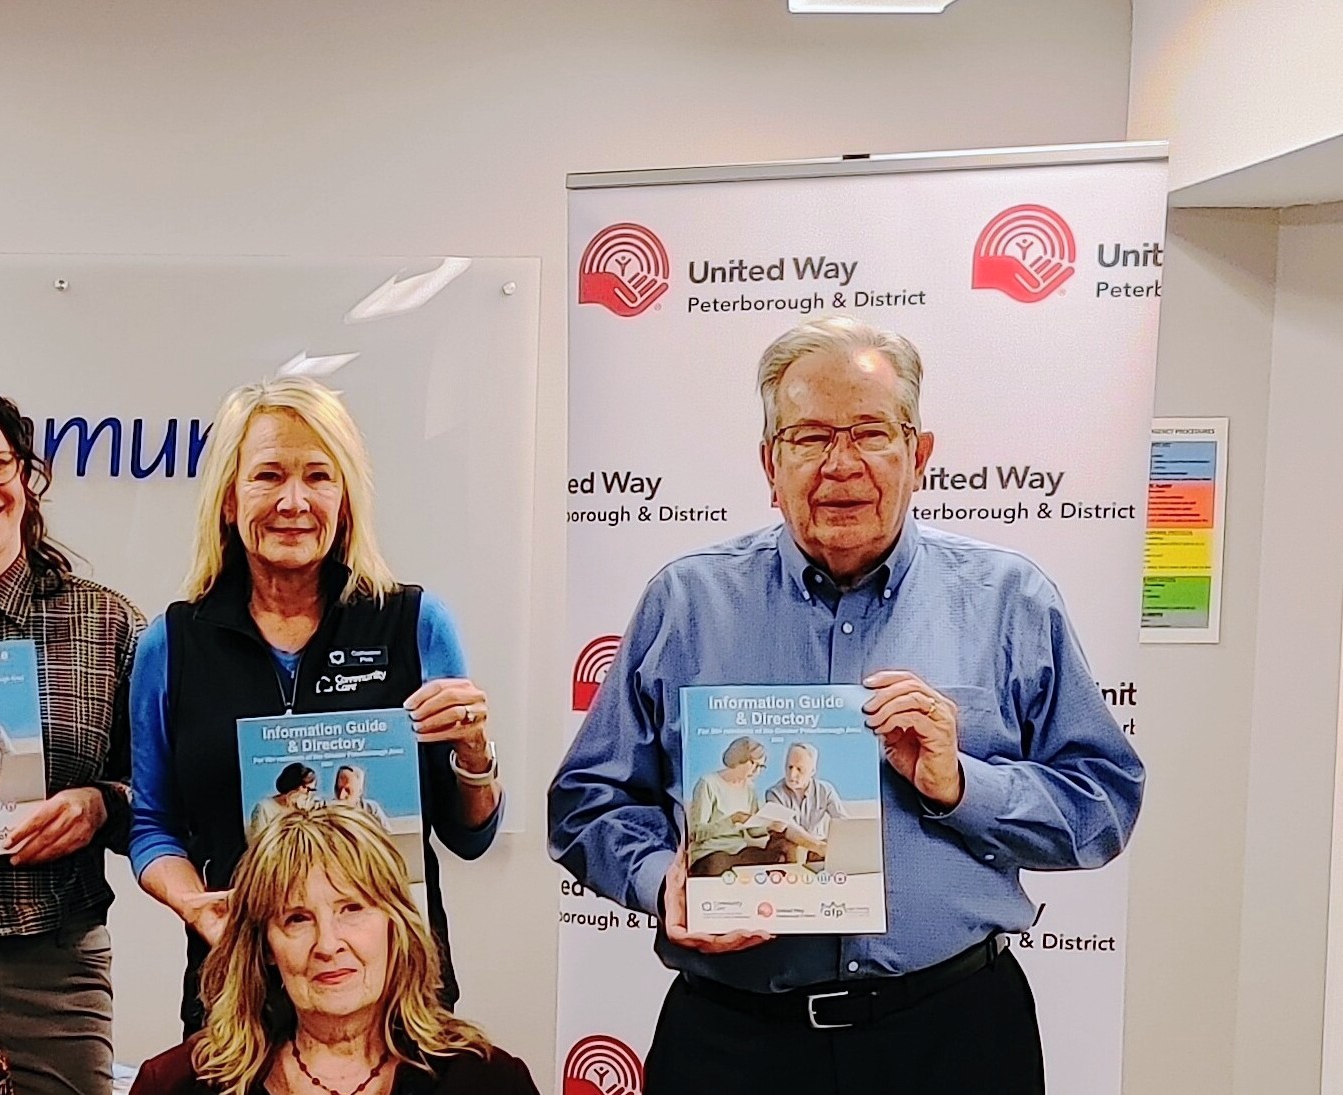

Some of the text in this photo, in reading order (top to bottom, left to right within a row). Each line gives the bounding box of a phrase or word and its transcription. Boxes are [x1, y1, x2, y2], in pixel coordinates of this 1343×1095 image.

[688, 255, 859, 287] United Way
[688, 290, 926, 314] Peterborough & District
[601, 471, 663, 501] Way
[913, 465, 1065, 497] ited Way
[637, 506, 652, 522] &
[659, 505, 728, 522] District
[912, 501, 1136, 524] terborough & District
[708, 694, 845, 711] Information Guide
[1096, 681, 1138, 706] nit
[262, 719, 388, 741] Information Guide
[735, 711, 820, 728] & Directory
[287, 737, 366, 754] & Directory
[626, 912, 641, 928] &
[1019, 931, 1034, 949] &
[1042, 933, 1116, 951] District
